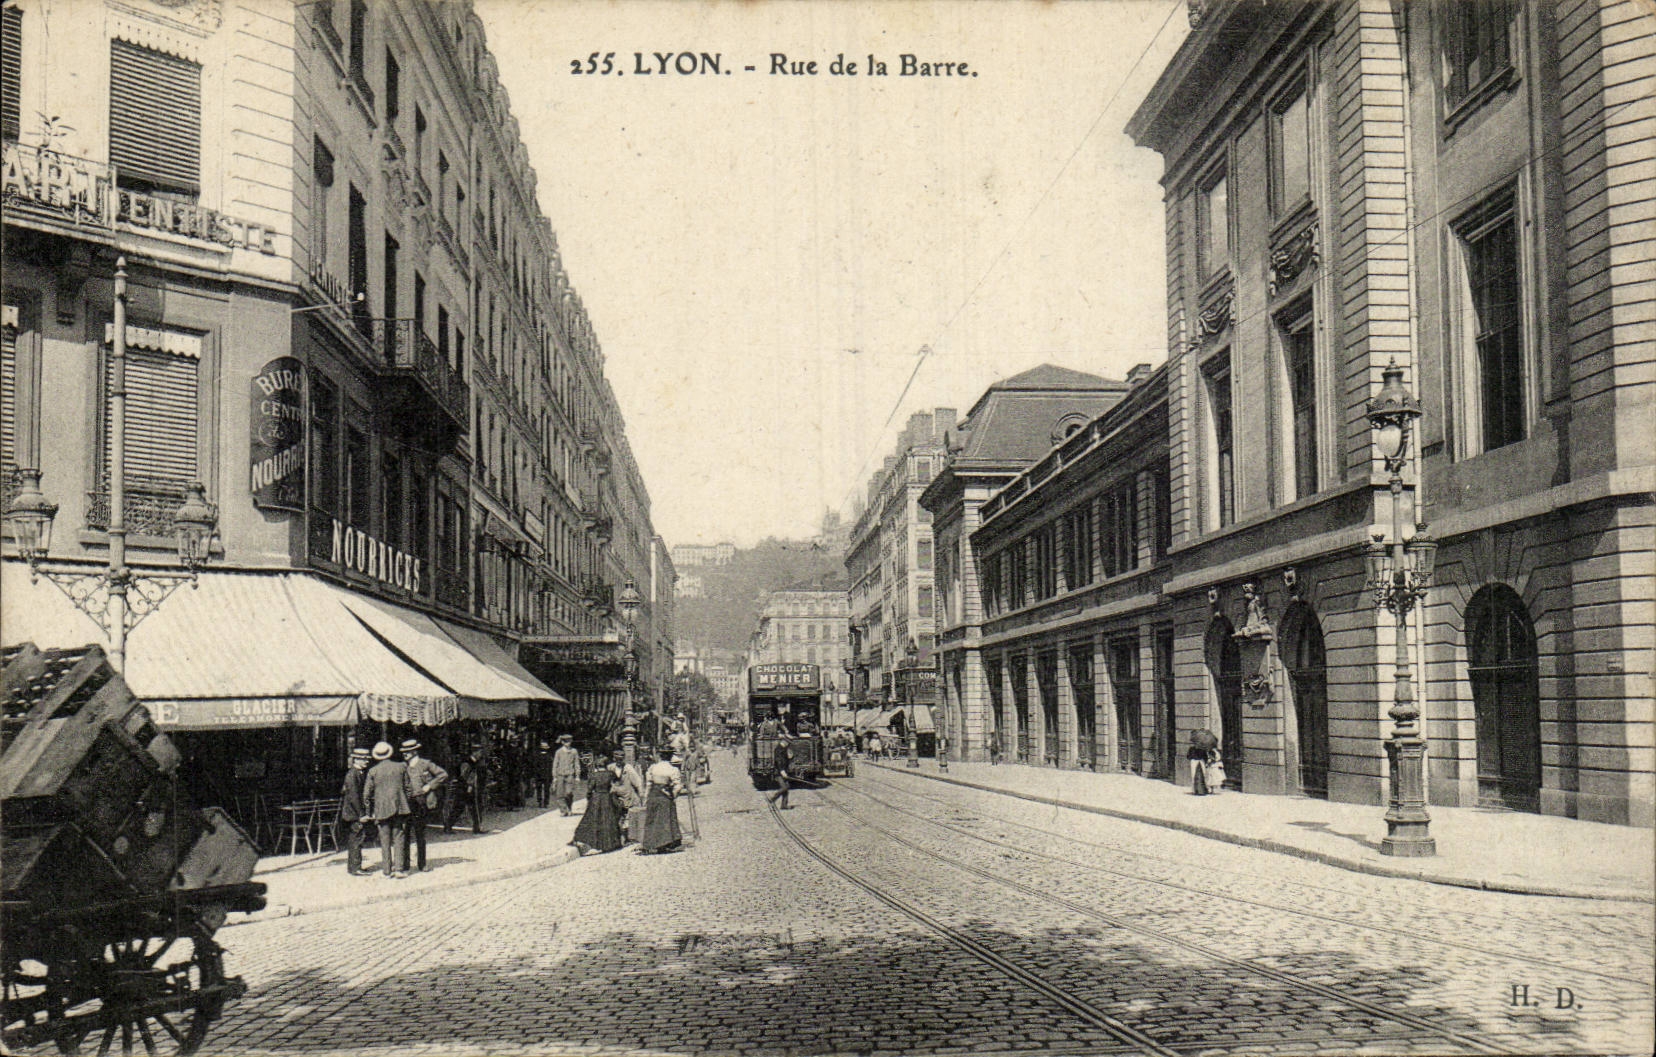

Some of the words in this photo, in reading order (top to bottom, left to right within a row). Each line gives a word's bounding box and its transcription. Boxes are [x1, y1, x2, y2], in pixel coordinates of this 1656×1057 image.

[331, 517, 421, 593] NOURRICES
[756, 664, 814, 673] CHOCOLAT
[759, 673, 811, 684] MENIER
[233, 698, 296, 714] GLACIER
